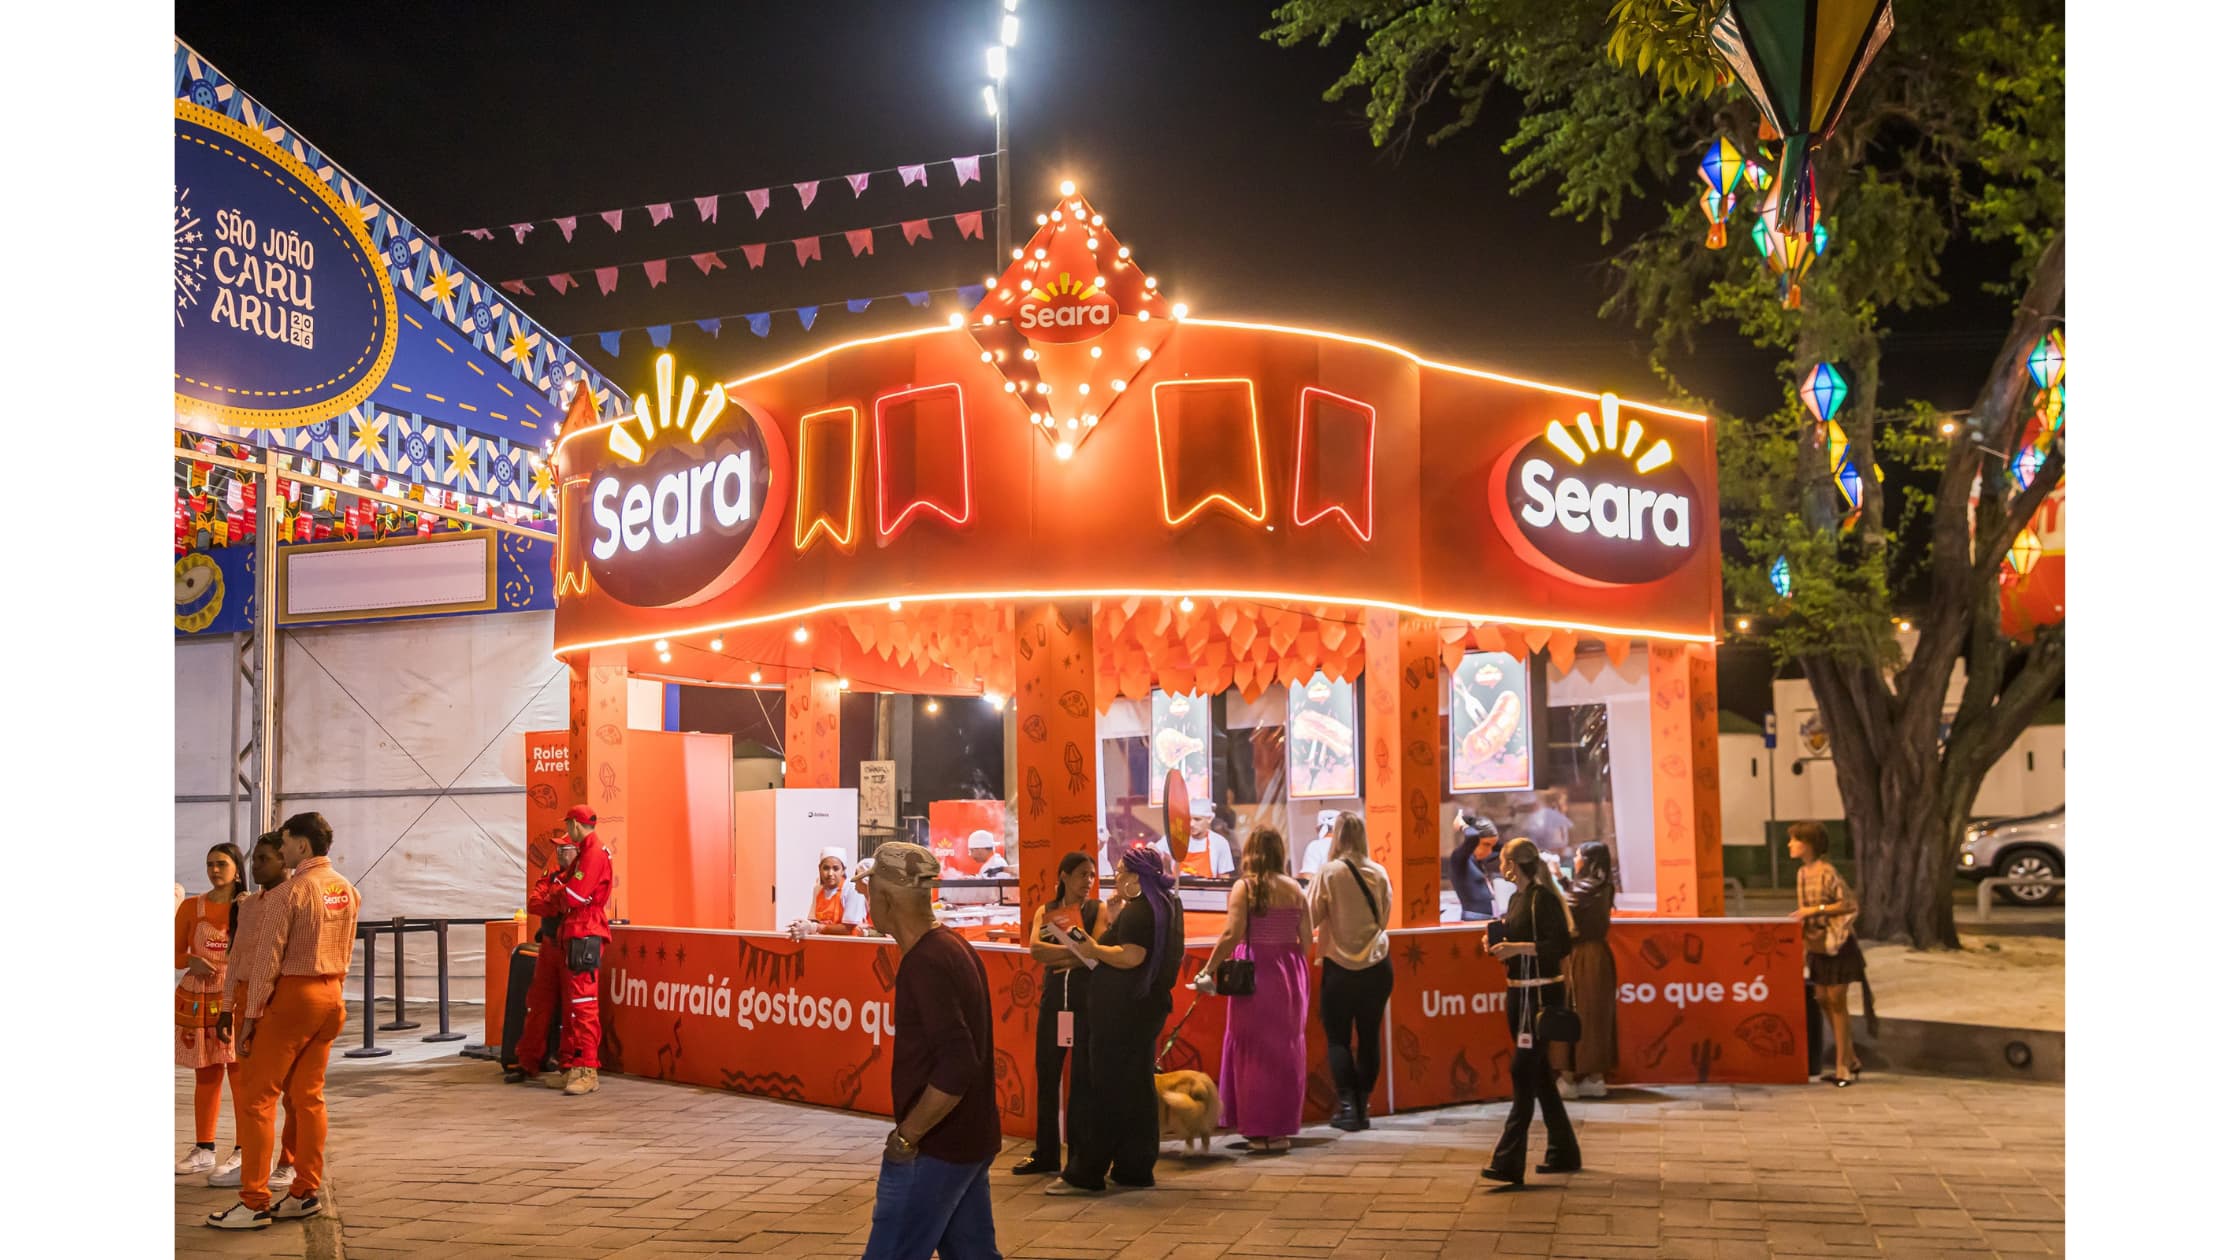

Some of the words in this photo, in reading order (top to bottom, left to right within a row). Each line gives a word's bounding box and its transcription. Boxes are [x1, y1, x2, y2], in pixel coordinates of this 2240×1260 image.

[215, 208, 256, 250] SÃO
[262, 228, 314, 271] JOÃO
[213, 246, 315, 310] CARU
[211, 286, 290, 343] ARU
[1020, 303, 1110, 329] Seara
[592, 449, 750, 560] Seara
[1521, 458, 1690, 547] Seara
[533, 746, 570, 760] Rolet
[534, 759, 570, 773] Arret
[323, 895, 349, 905] Seara
[205, 940, 229, 949] Seara
[610, 967, 648, 1008] Um
[653, 973, 731, 1018] arraiá
[738, 986, 852, 1031] gostoso
[1422, 990, 1466, 1017] Um
[1615, 982, 1657, 1003] so
[1663, 981, 1725, 1009] que
[1732, 975, 1769, 1003] só
